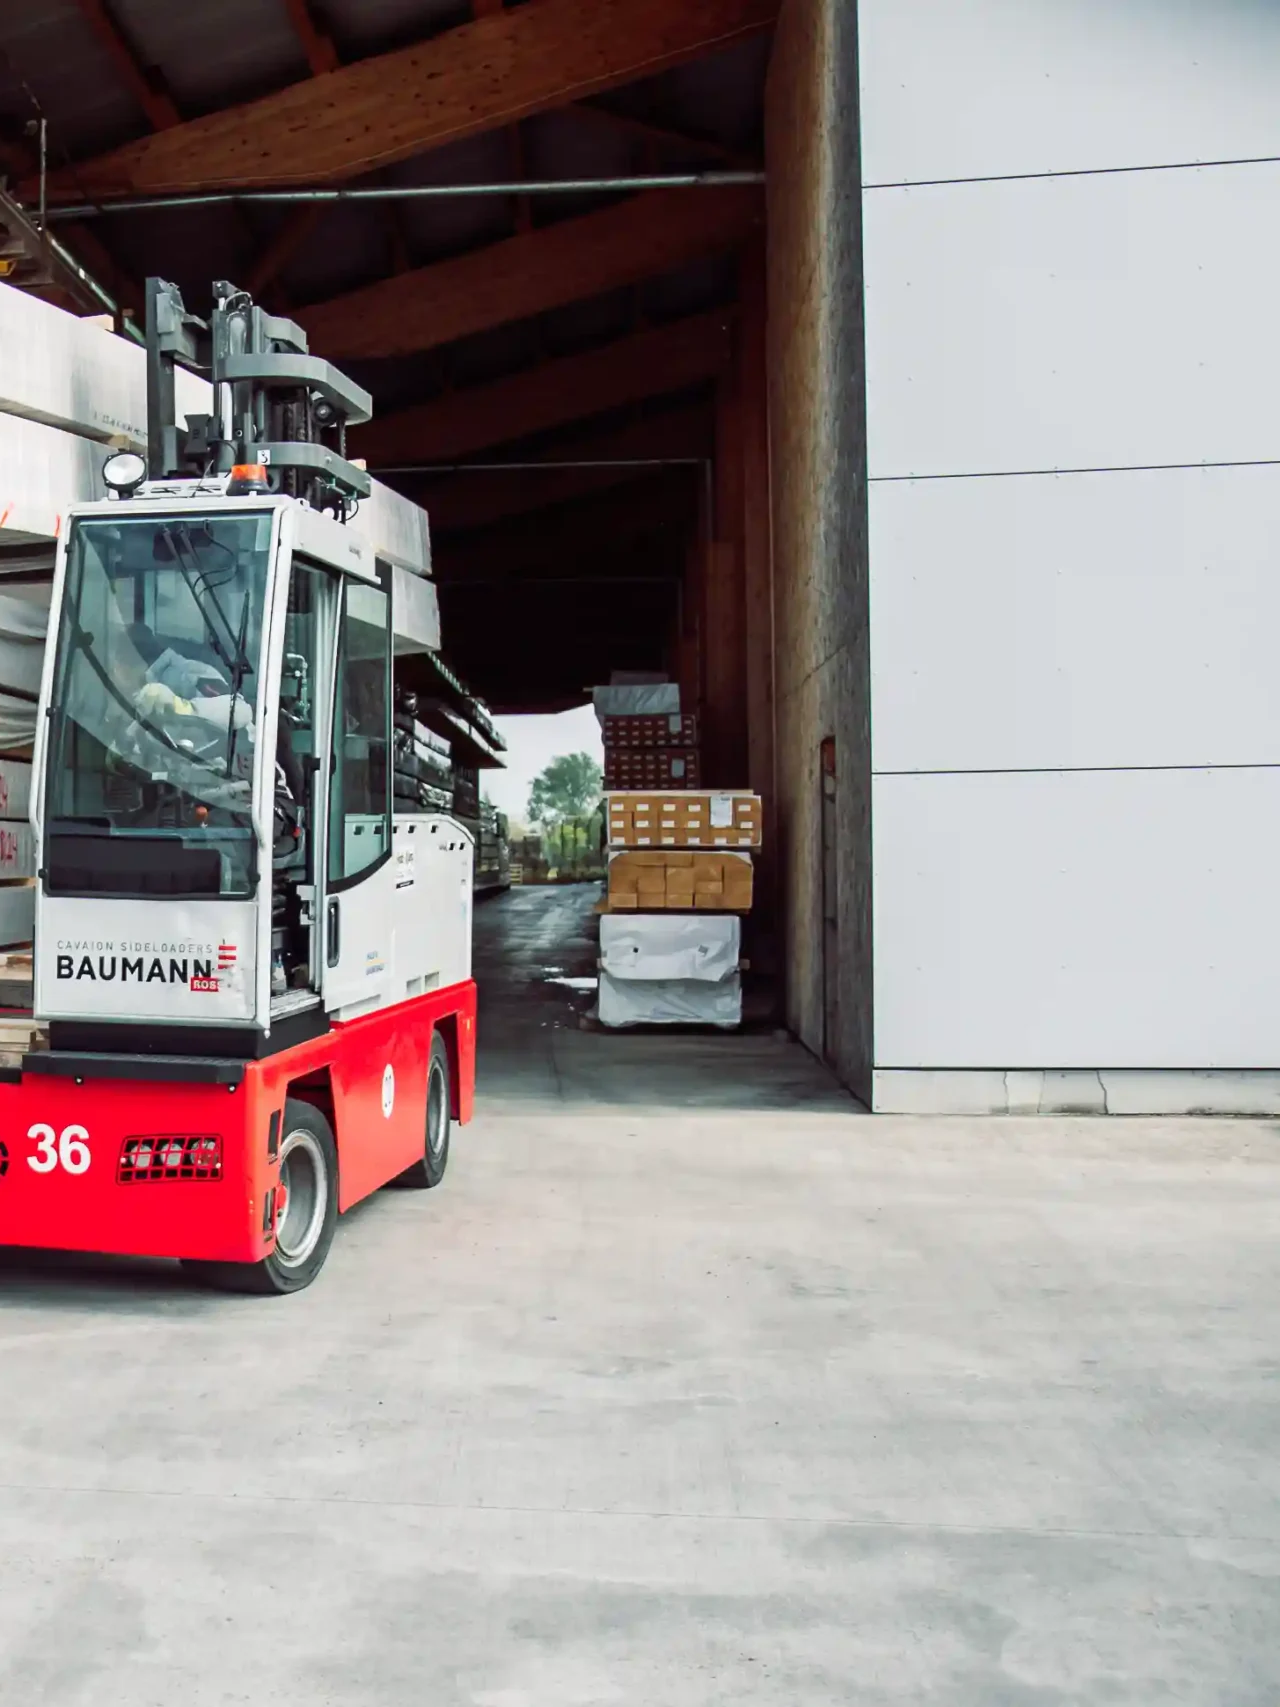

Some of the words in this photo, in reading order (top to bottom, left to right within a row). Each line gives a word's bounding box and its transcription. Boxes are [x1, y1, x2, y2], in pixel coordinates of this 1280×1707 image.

[57, 940, 114, 951] CAVAION
[120, 942, 213, 954] SIDELOADERS
[56, 955, 212, 983] BAUMANN
[26, 1123, 92, 1175] 36
